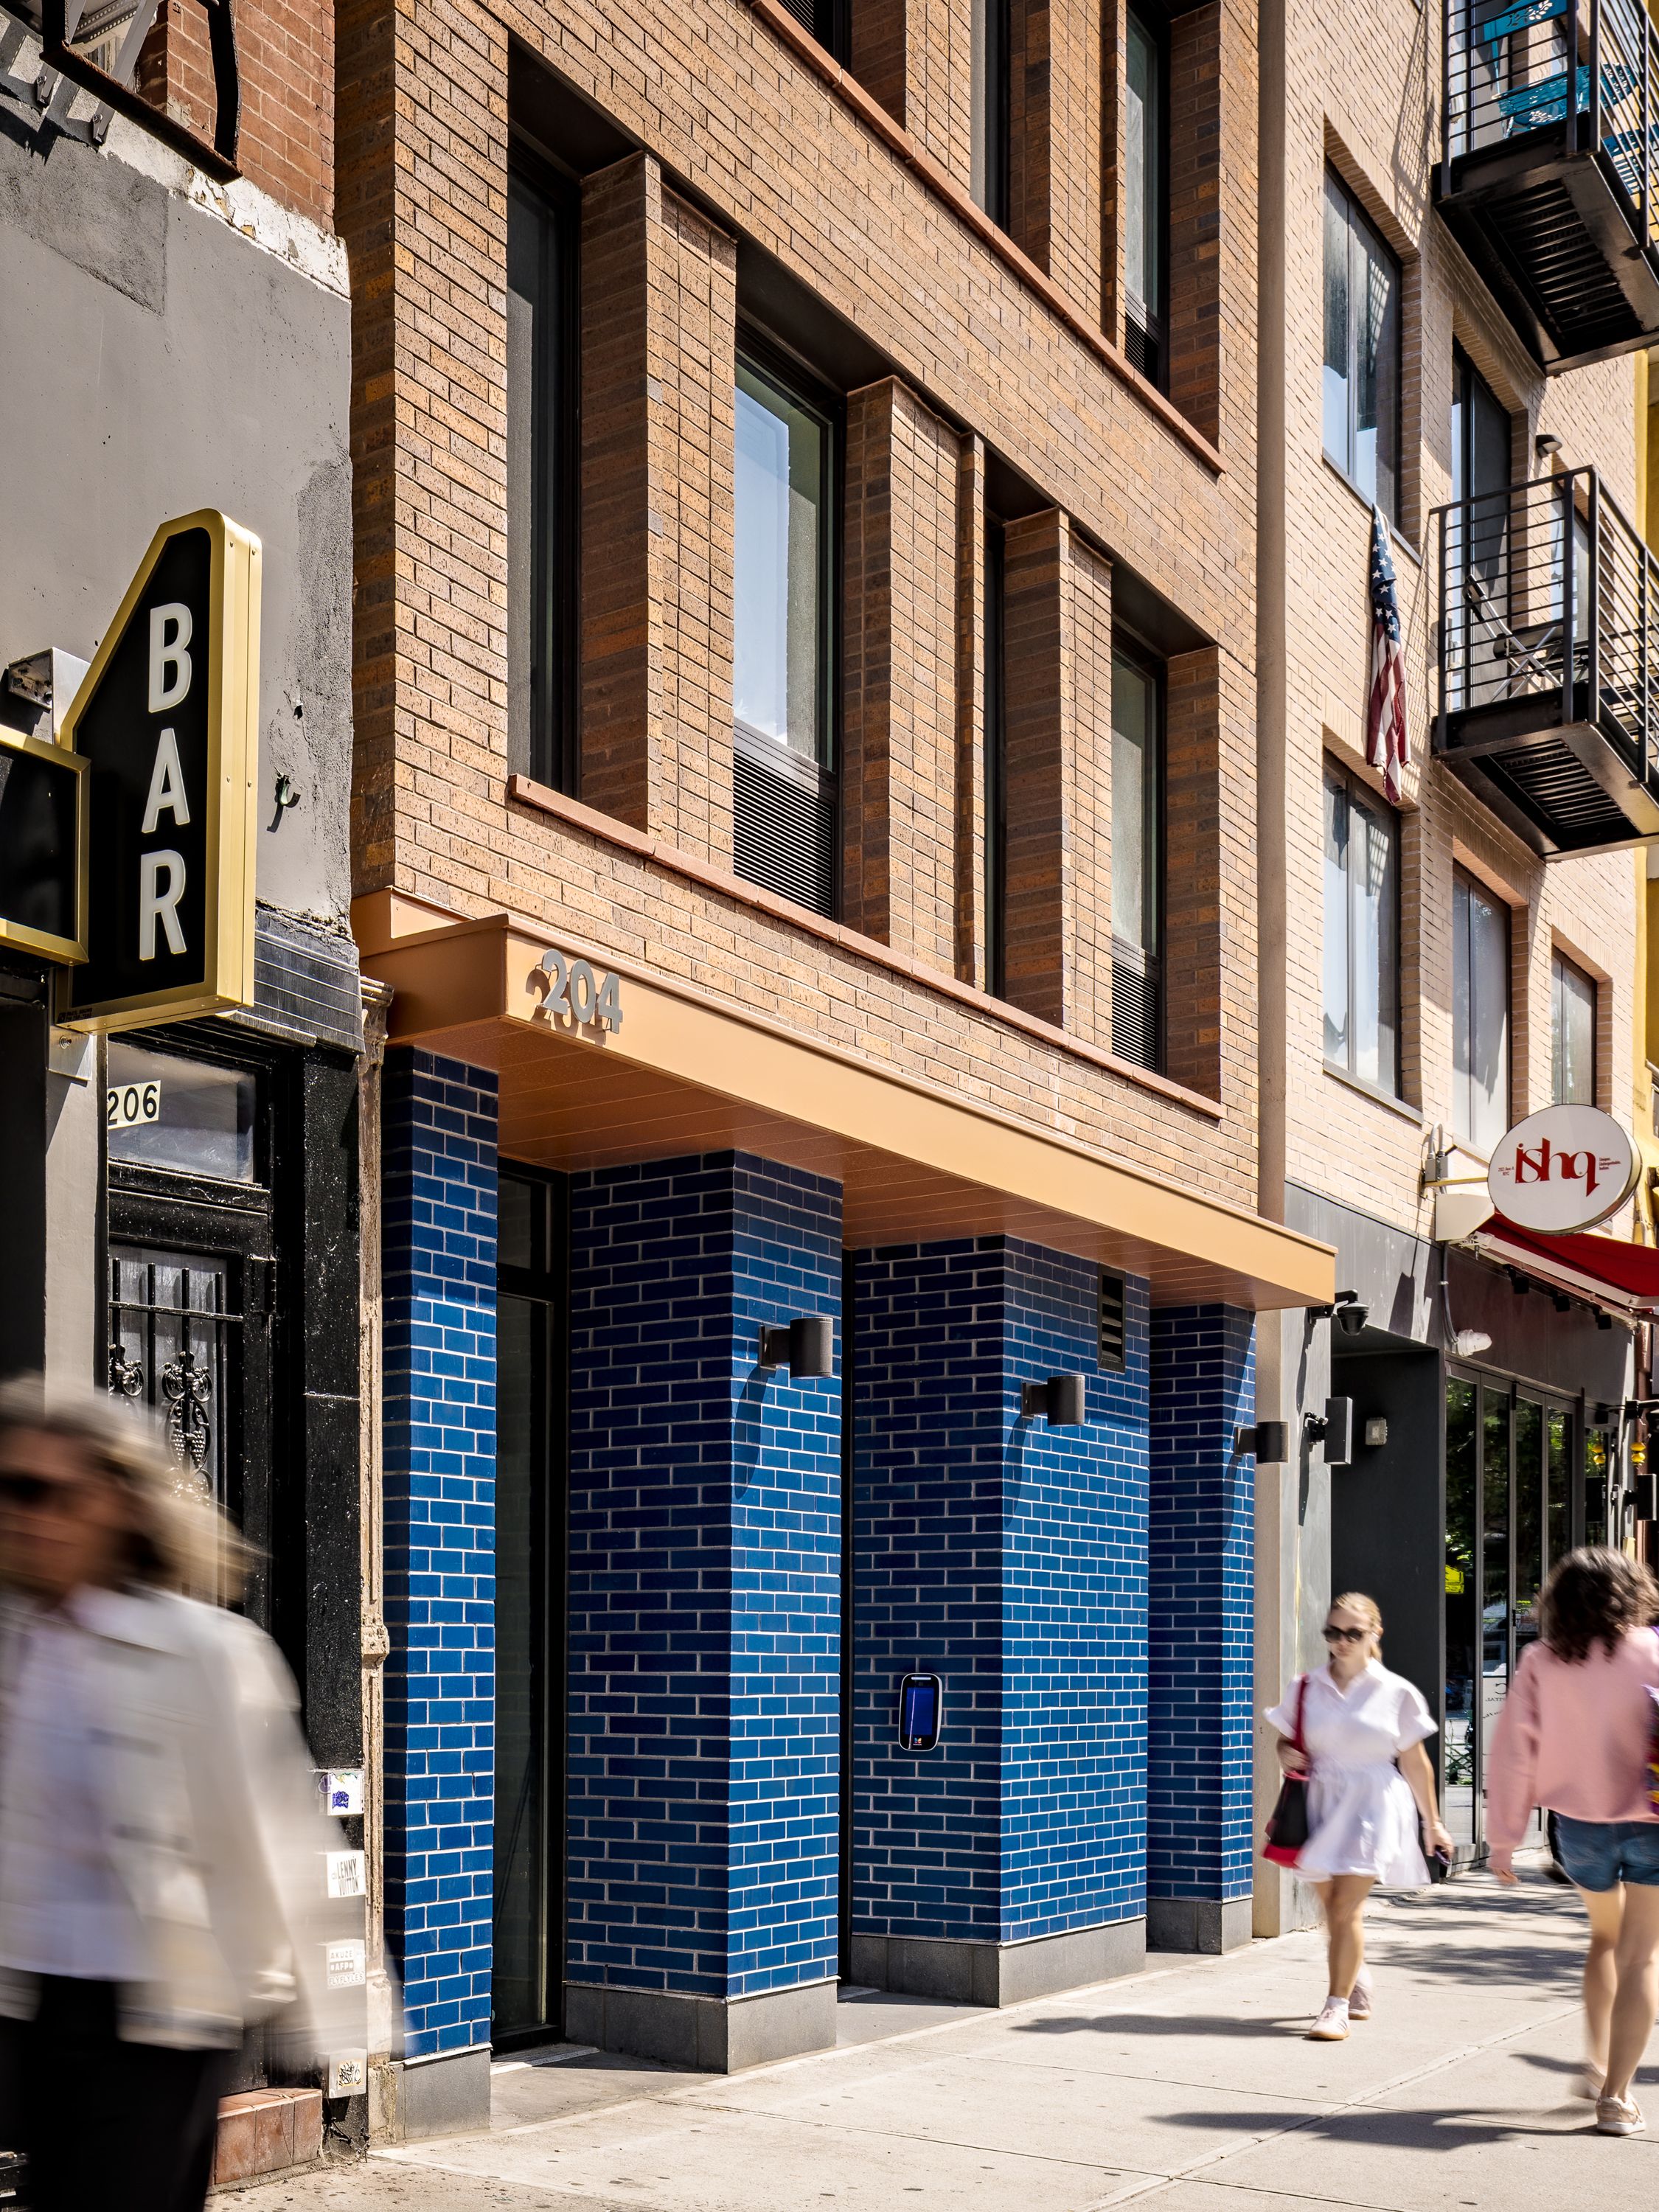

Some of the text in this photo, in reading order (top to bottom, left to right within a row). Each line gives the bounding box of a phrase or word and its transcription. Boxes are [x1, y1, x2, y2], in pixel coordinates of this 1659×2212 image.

[140, 602, 192, 961] BAR
[541, 948, 623, 1034] 204
[108, 1084, 157, 1126] 206
[1515, 1137, 1600, 1197] ishq
[336, 1857, 357, 1879] LENNY
